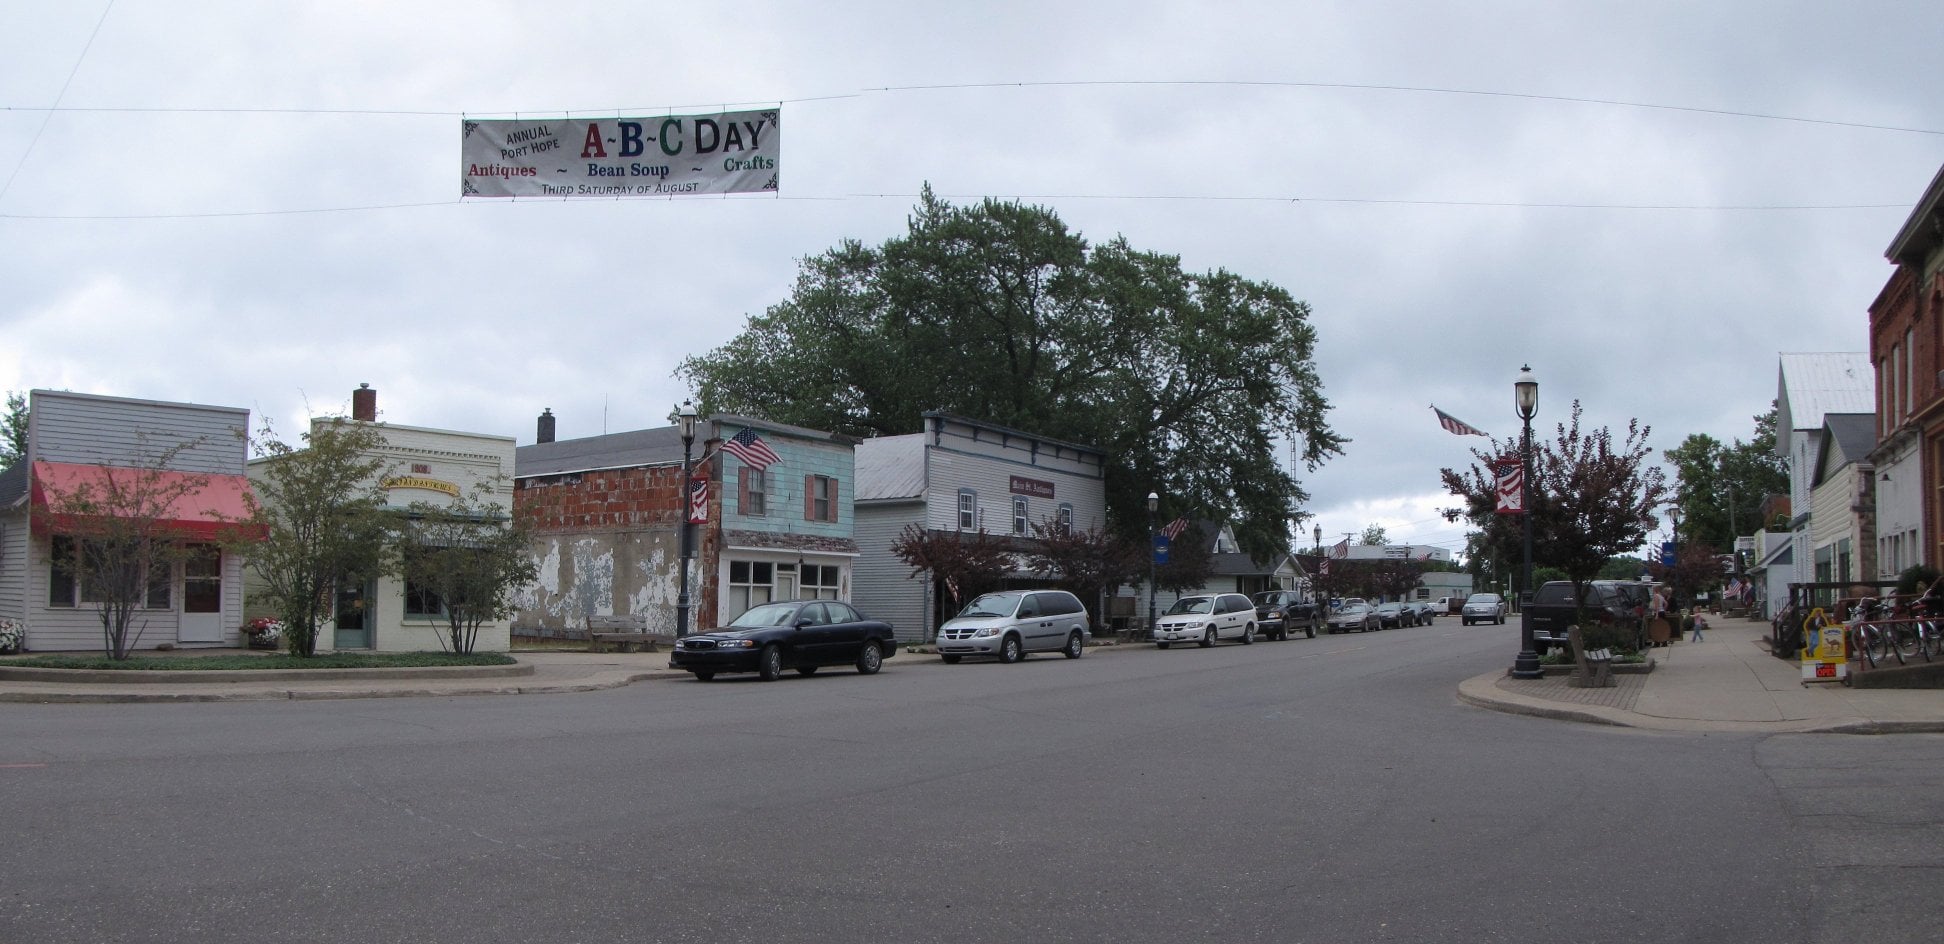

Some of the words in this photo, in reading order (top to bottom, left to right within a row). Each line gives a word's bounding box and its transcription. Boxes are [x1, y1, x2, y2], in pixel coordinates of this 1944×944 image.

[506, 125, 552, 145] ANNUAL
[695, 118, 766, 153] DAY
[501, 143, 529, 161] PORT
[531, 139, 560, 153] HOPE
[468, 163, 537, 179] Antiques
[588, 163, 624, 177] Bean
[631, 163, 670, 179] Soup
[724, 156, 774, 172] Crafts
[542, 184, 574, 195] THIRD
[578, 184, 633, 195] SATURDAY
[637, 185, 651, 194] OF
[655, 182, 699, 193] AUGUST
[1817, 668, 1835, 676] OPEN
